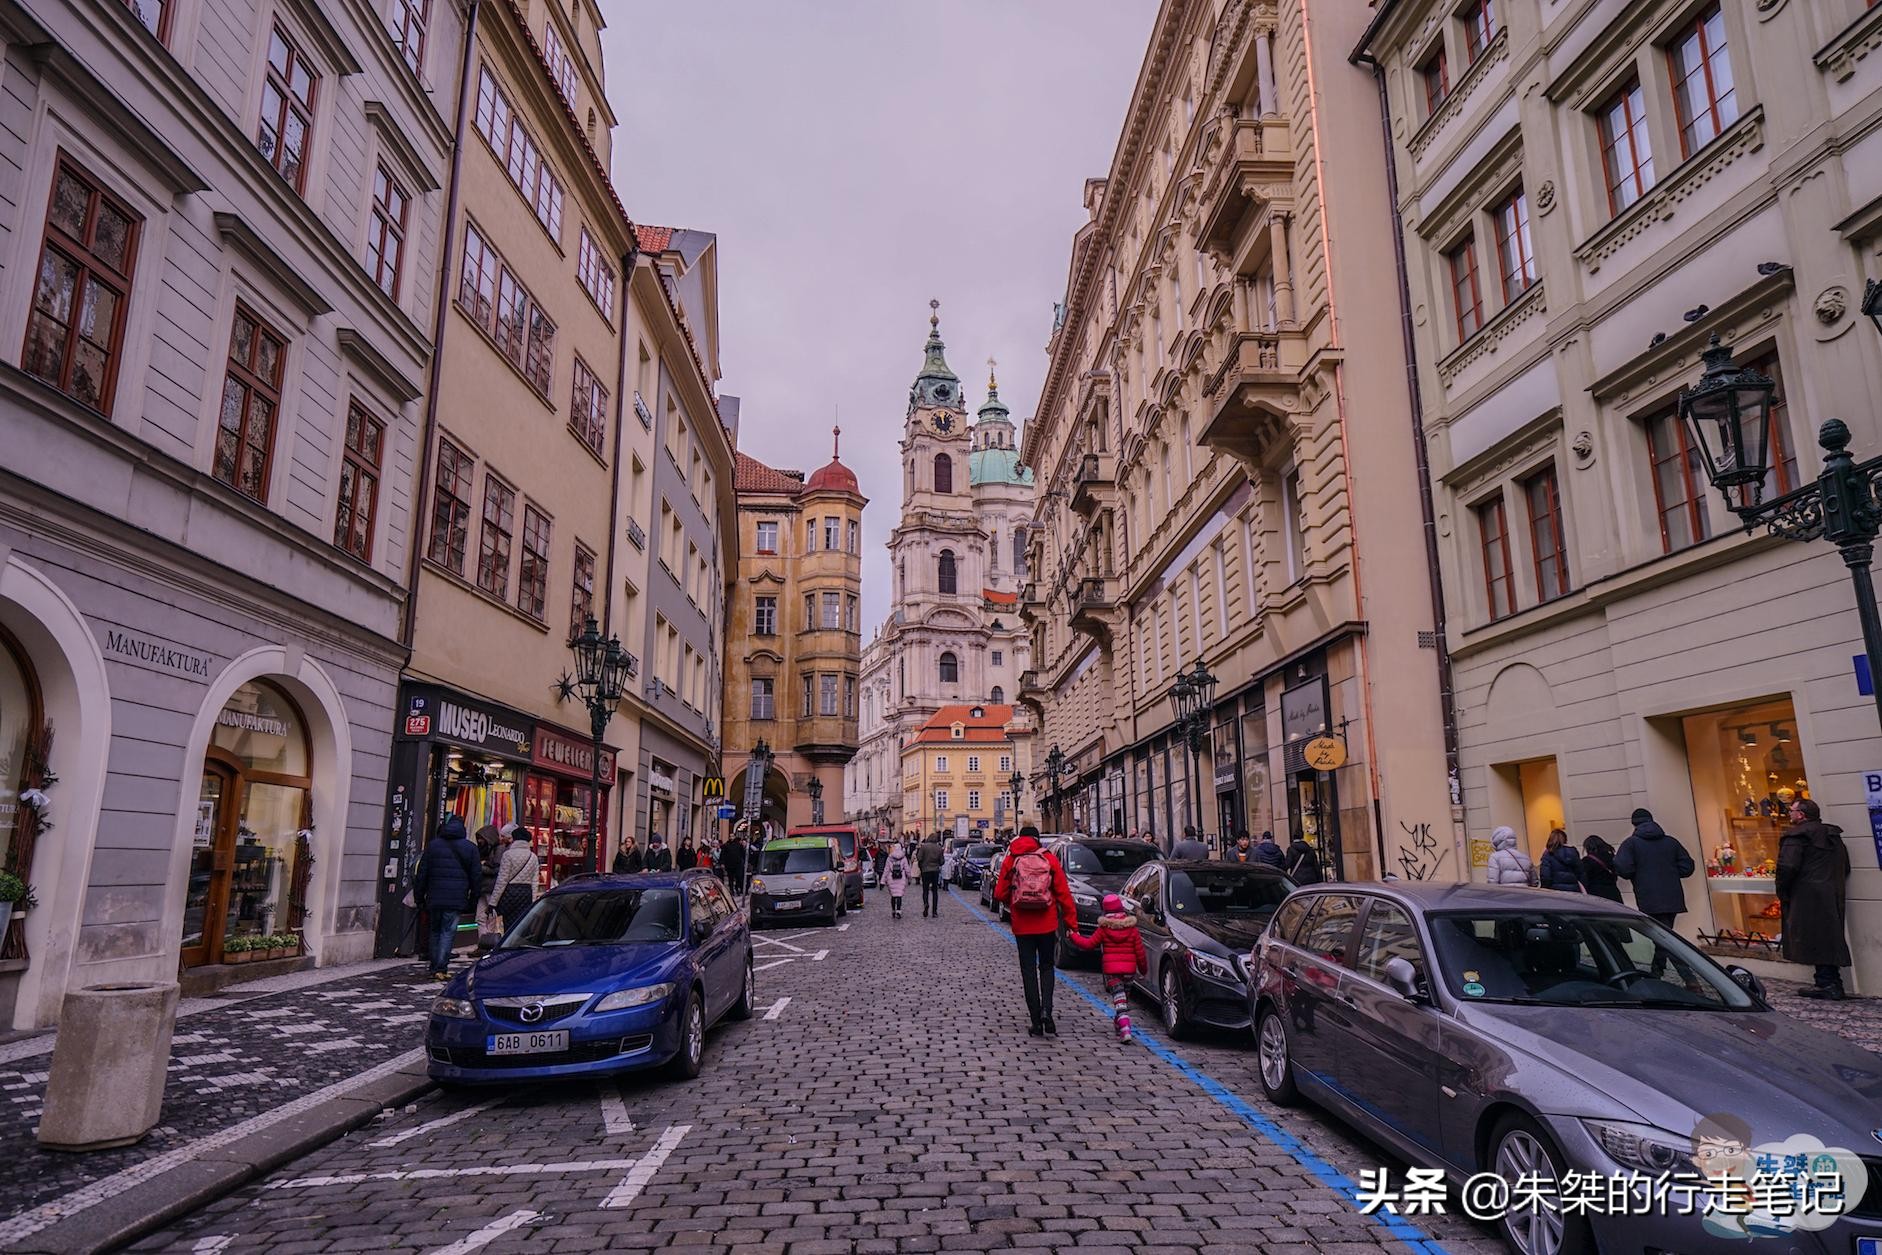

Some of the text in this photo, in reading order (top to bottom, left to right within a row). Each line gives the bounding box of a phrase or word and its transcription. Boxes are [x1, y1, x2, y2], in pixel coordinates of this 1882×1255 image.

[415, 699, 425, 708] 19
[410, 717, 425, 727] 275
[439, 700, 487, 744] MUSEO
[497, 1033, 562, 1050] 6AB 0611
